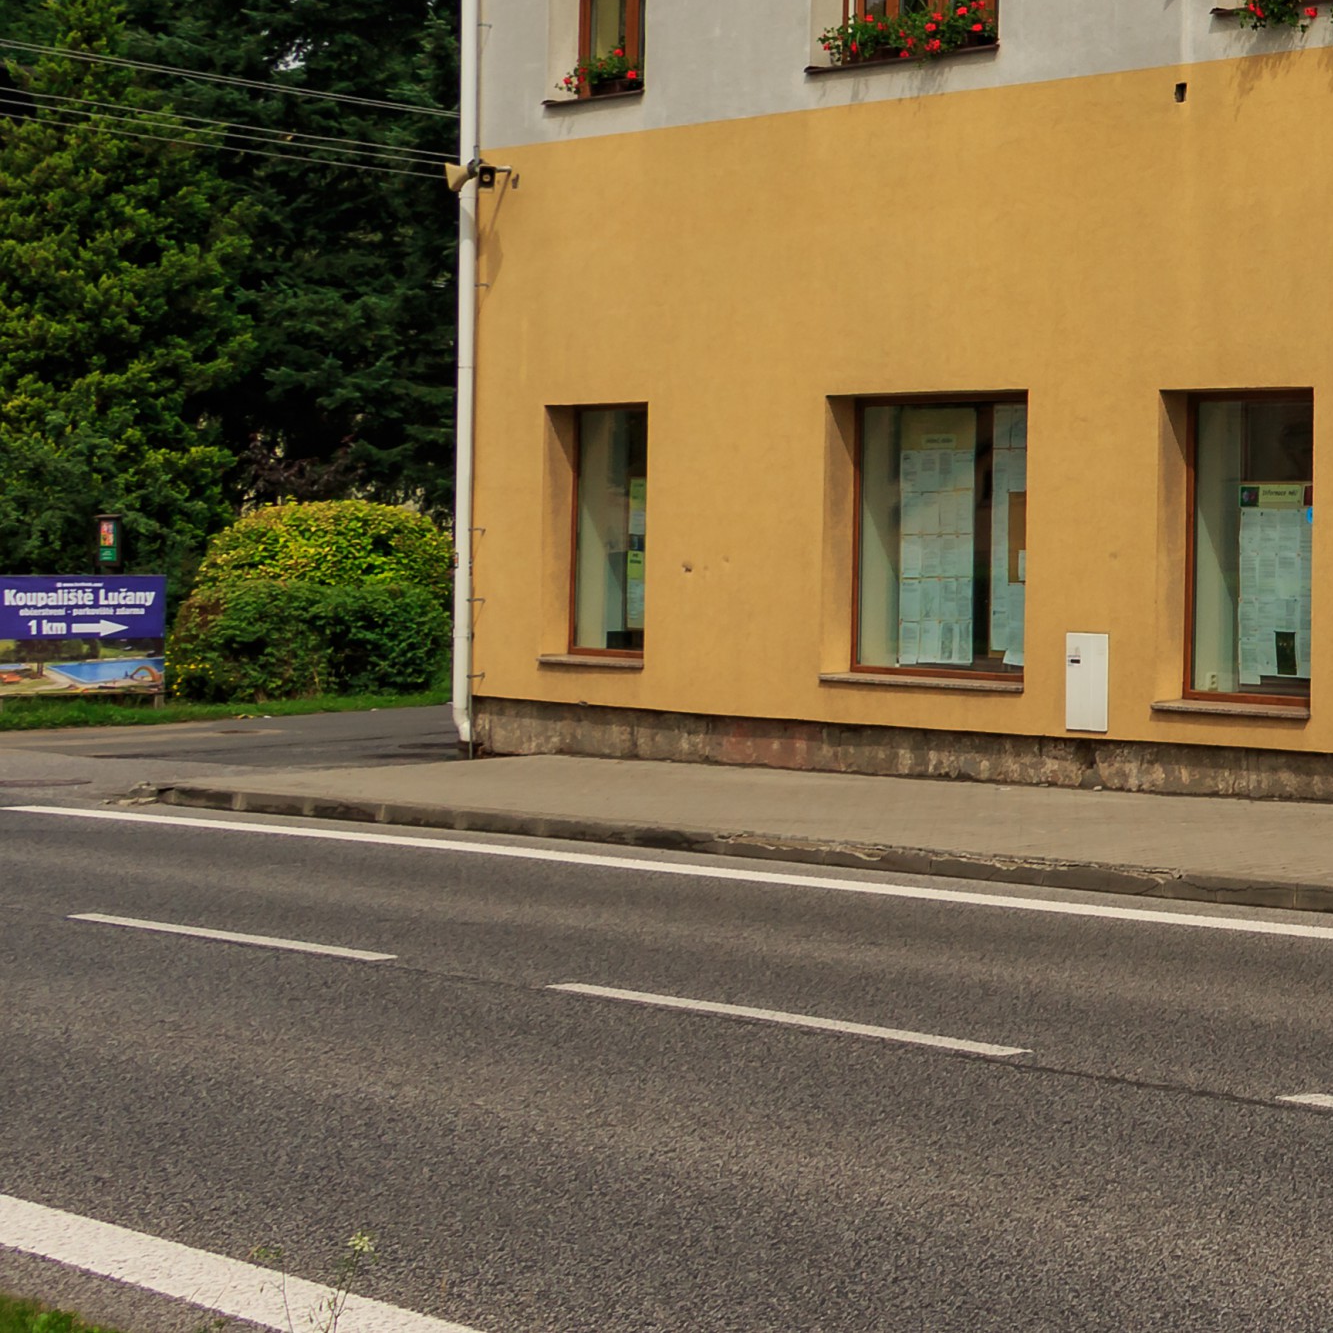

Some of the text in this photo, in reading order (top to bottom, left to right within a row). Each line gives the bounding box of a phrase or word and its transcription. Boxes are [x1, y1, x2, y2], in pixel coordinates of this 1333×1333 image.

[4, 588, 156, 607] Koupaliště Lučany
[27, 619, 67, 635] 1 km
